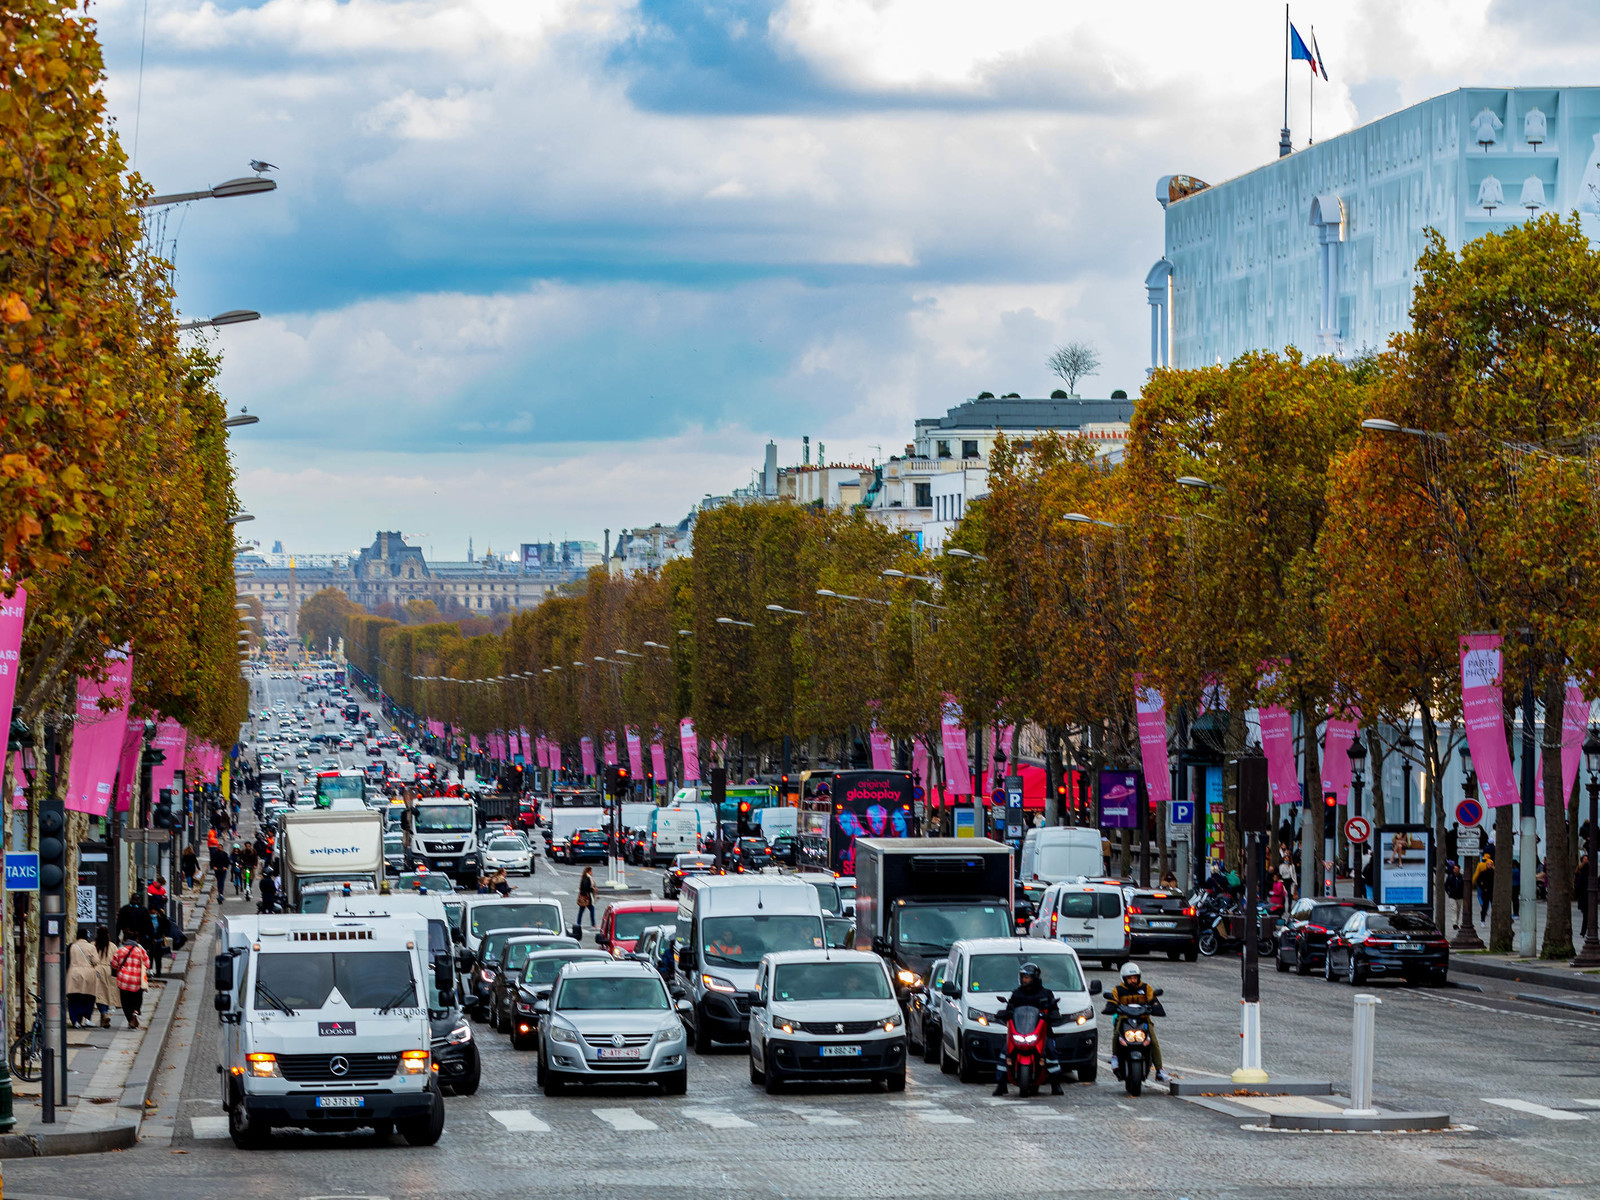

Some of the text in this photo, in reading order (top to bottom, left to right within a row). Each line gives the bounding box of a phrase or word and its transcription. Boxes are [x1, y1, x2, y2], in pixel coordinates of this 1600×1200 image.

[1468, 658, 1494, 668] PARIS
[1465, 666, 1497, 678] PHOTO
[858, 779, 890, 790] original
[846, 788, 901, 801] globoplay
[1178, 805, 1189, 821] P
[310, 846, 360, 855] swipop.fr
[6, 865, 37, 878] TAXIS
[320, 1027, 354, 1036] LOOMIS
